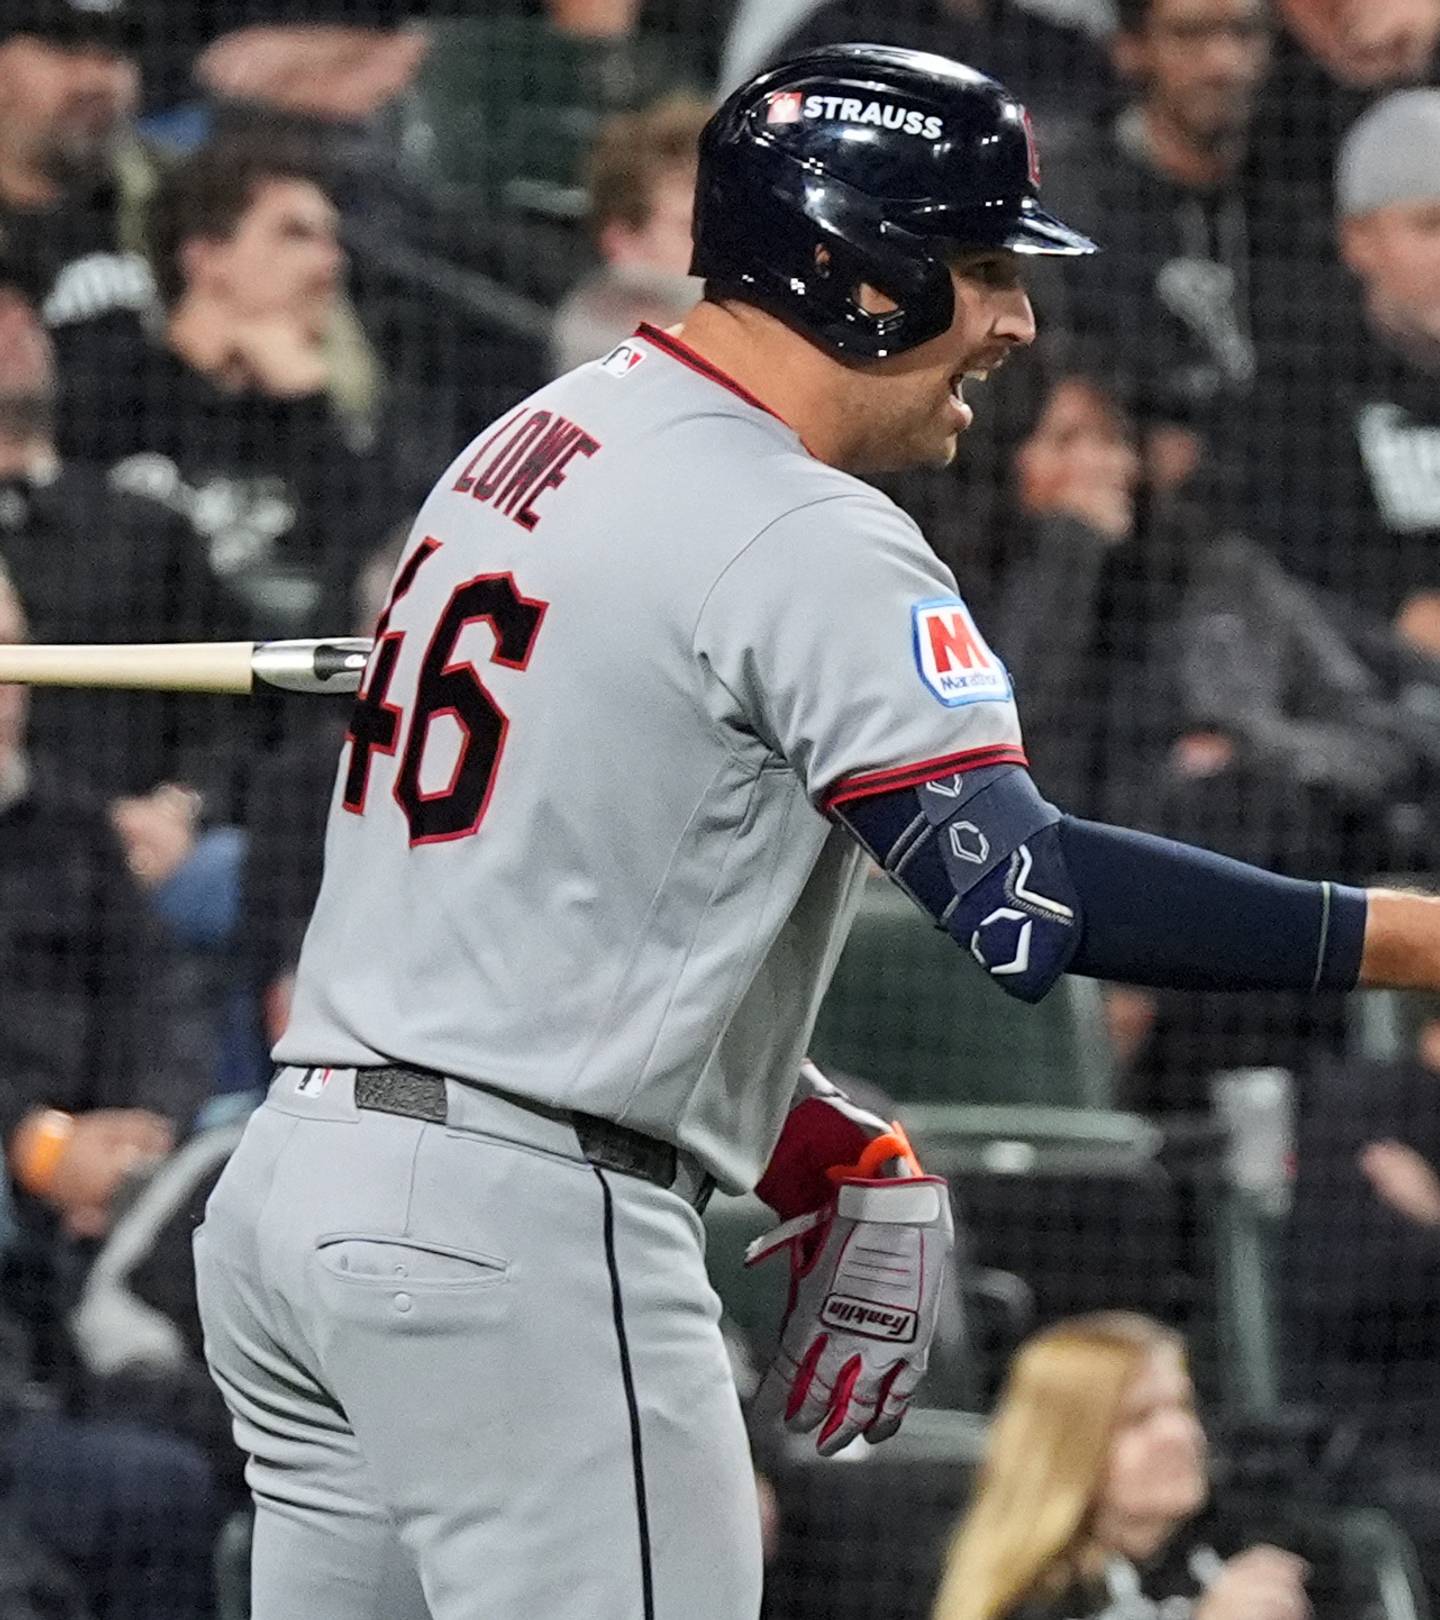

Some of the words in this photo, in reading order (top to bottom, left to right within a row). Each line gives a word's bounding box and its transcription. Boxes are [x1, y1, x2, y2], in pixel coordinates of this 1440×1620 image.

[803, 96, 943, 139] STRAUSS
[452, 407, 603, 533] LOWE
[926, 613, 990, 673] M
[342, 535, 550, 850] 46
